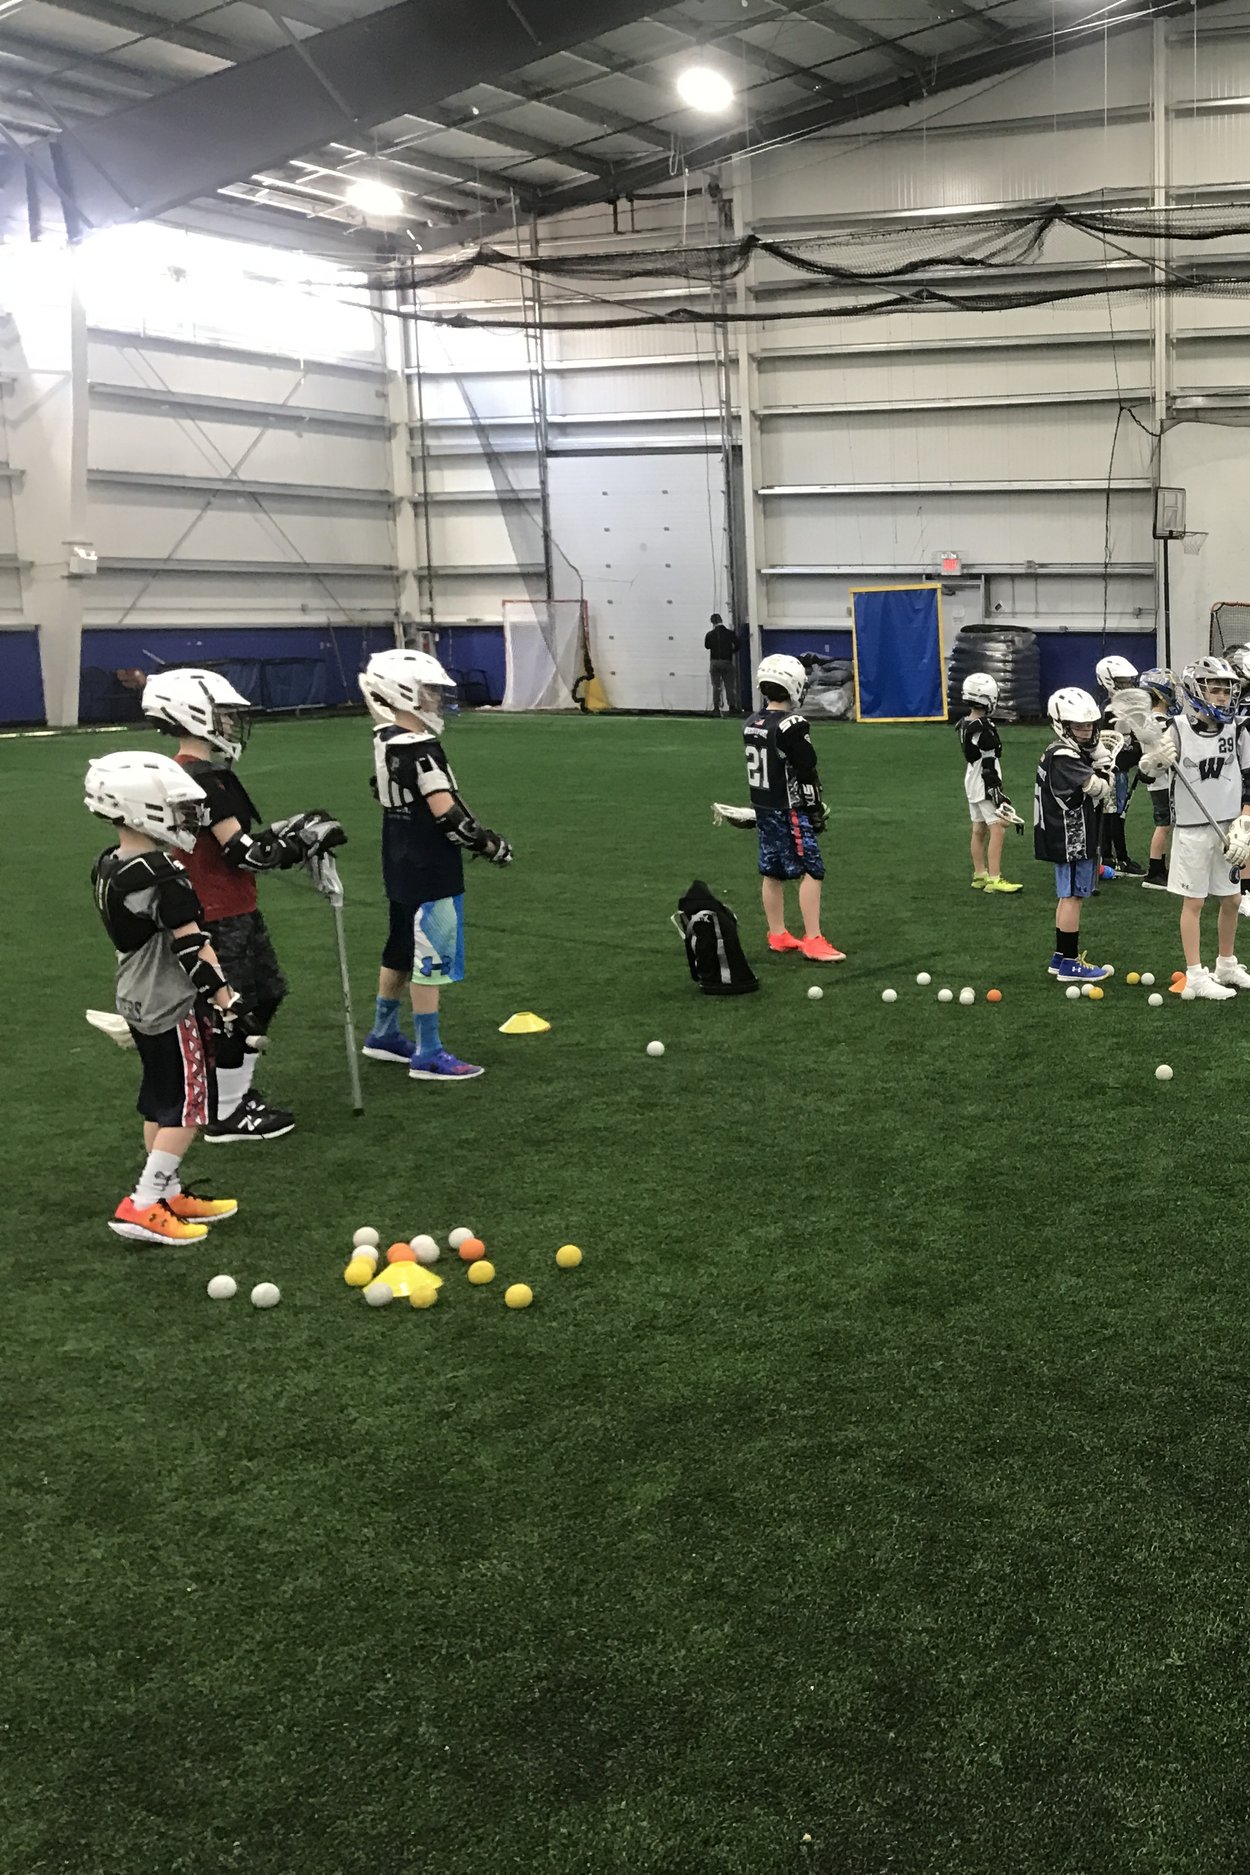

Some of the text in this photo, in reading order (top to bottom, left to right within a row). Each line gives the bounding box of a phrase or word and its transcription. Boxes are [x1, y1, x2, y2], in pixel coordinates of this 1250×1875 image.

[1218, 737, 1234, 754] 29
[745, 745, 770, 789] 21
[1198, 756, 1226, 781] W
[801, 783, 816, 807] STX
